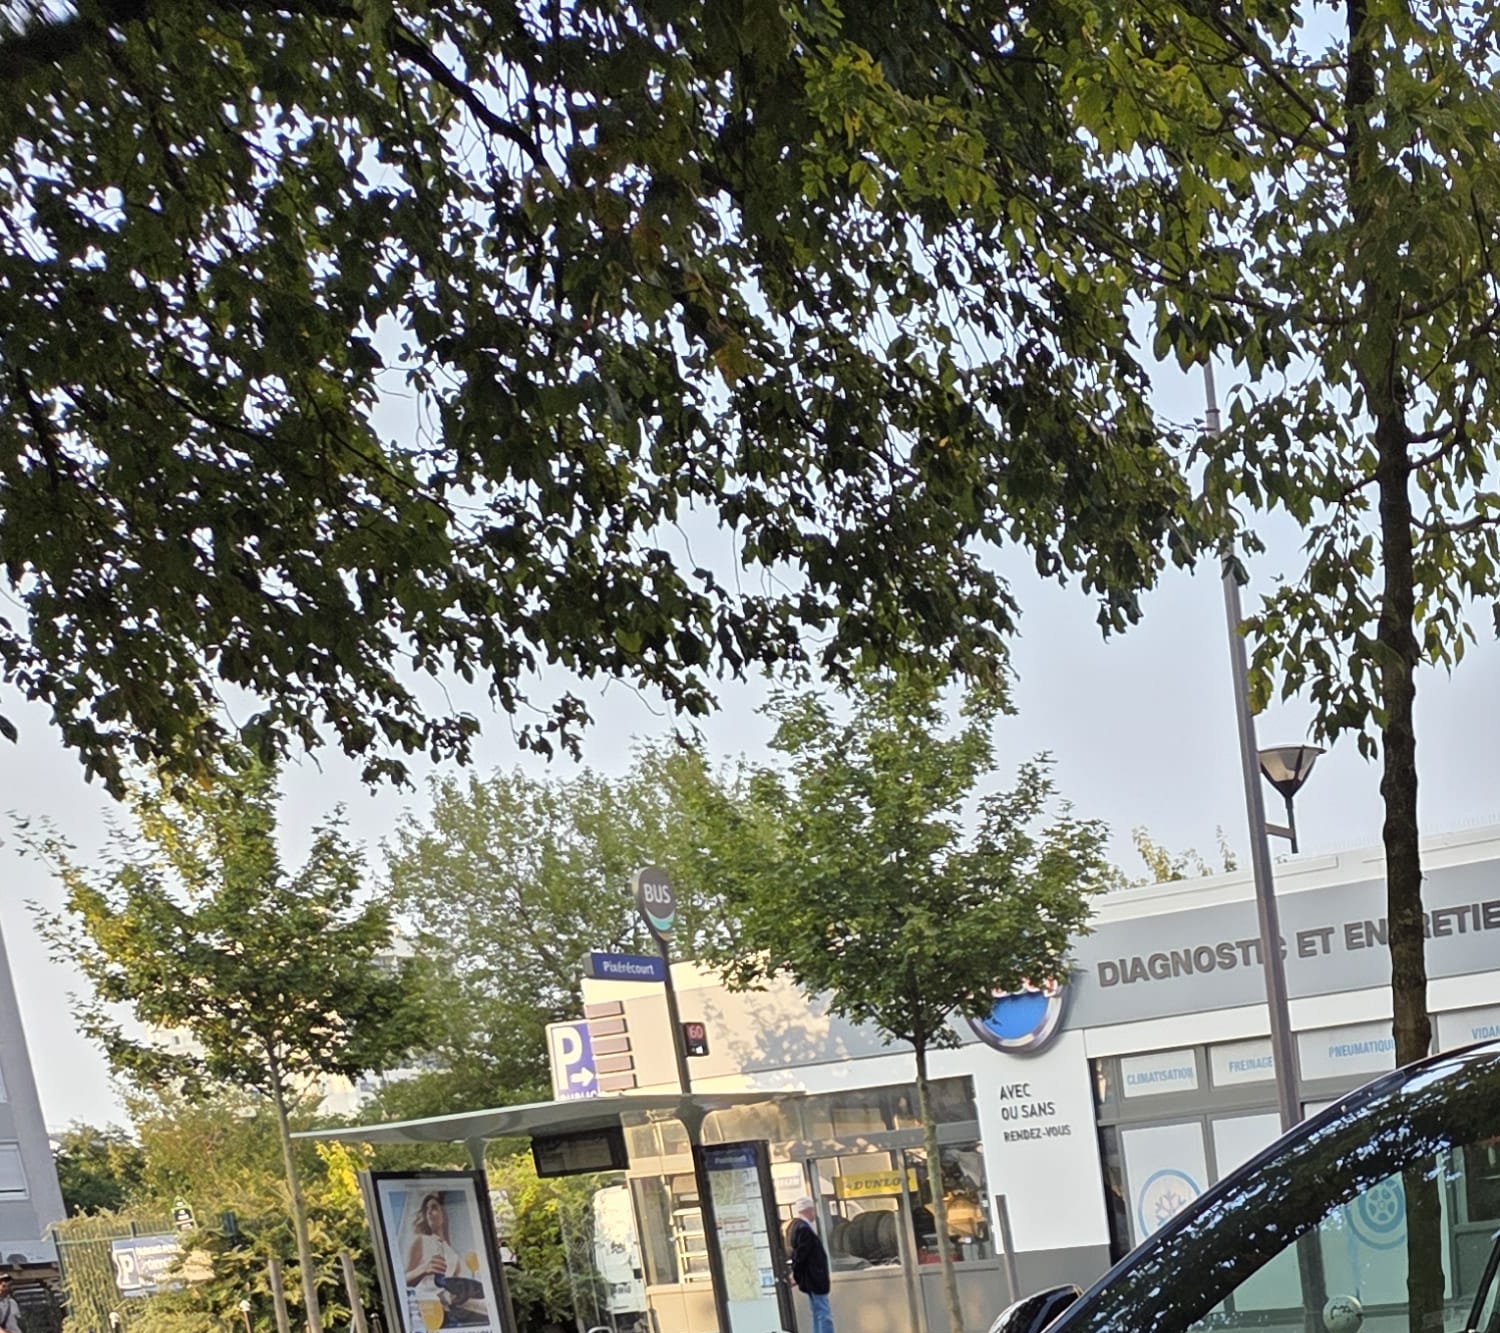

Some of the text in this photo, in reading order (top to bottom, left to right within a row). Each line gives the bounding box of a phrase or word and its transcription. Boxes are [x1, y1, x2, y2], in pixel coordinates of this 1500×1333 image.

[644, 883, 671, 904] BUS
[1296, 927, 1335, 958] ET
[603, 960, 655, 976] Pixérécourt
[552, 1027, 582, 1089] P
[1229, 1056, 1273, 1073] FREINAGE
[1127, 1066, 1194, 1086] CLIMATISATION
[1000, 1083, 1031, 1100] AVEC
[1001, 1102, 1056, 1121] OU SANS
[1004, 1125, 1072, 1142] RENDEZ-VOUS
[854, 1177, 907, 1190] DUNLO
